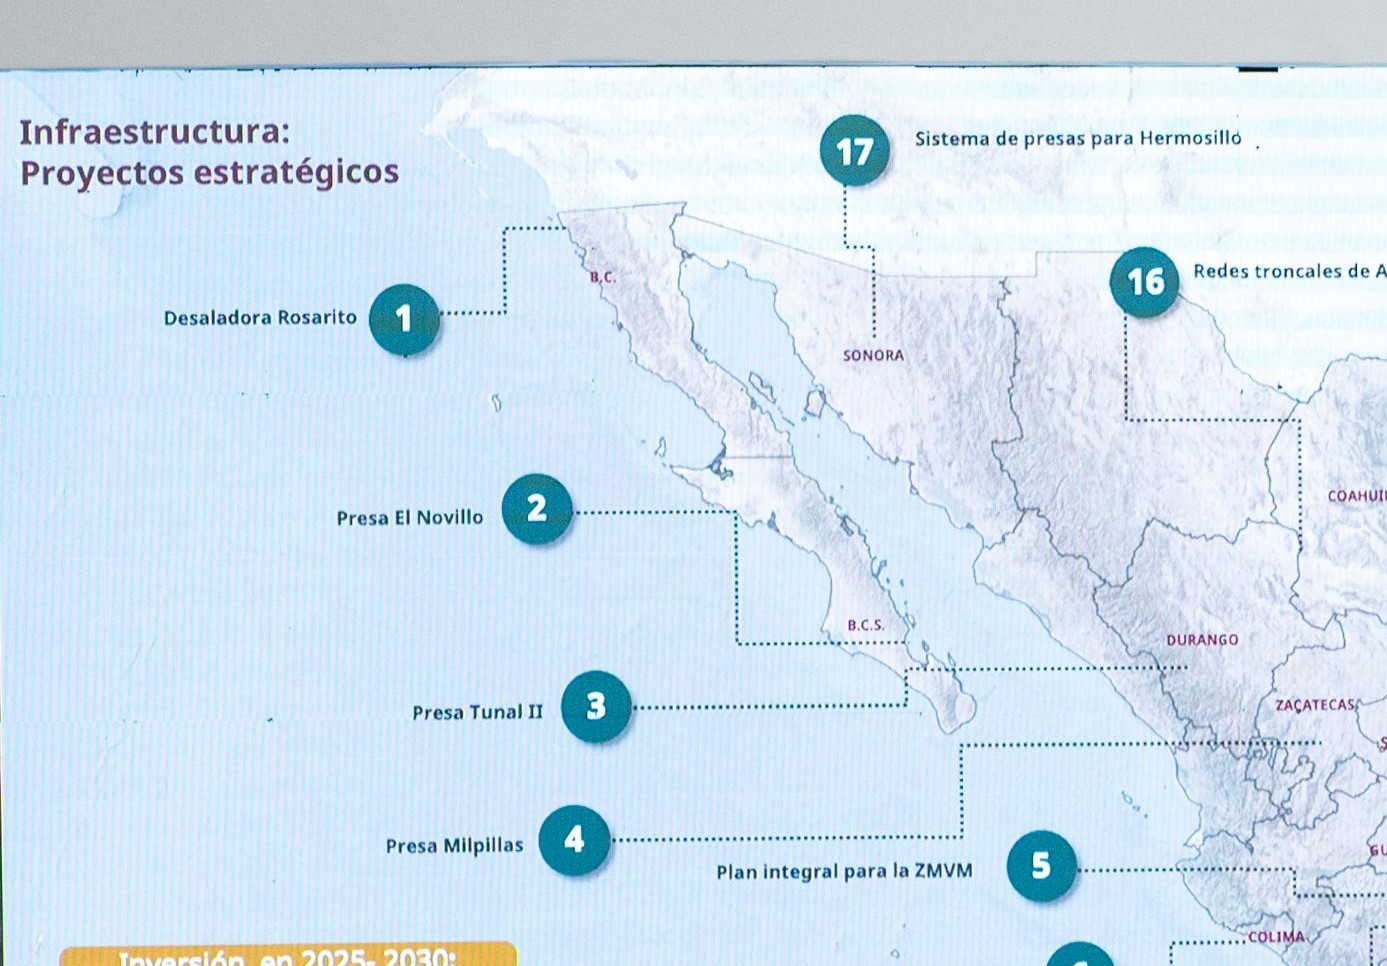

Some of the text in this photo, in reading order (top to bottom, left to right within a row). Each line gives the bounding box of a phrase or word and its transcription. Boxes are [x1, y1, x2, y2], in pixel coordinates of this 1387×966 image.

[20, 118, 290, 146] Infraestructura:
[916, 129, 1242, 150] Sistema de presas para Hermosillo
[836, 136, 874, 166] 17
[21, 156, 400, 193] Proyectos estratégicos
[591, 271, 616, 283] B.C.
[1127, 266, 1165, 296] 16
[1194, 263, 1248, 279] Redes
[1255, 263, 1342, 278] troncales
[1348, 263, 1370, 278] de
[165, 308, 358, 327] Desaladora Rosarito
[395, 305, 411, 332] 1
[843, 348, 904, 362] SONORA
[527, 493, 547, 521] 2
[337, 508, 484, 527] Presa El Novillo
[848, 618, 886, 633] B.C.S.
[1166, 633, 1239, 647] DURANGO
[413, 703, 544, 722] Presa Tunal II
[586, 693, 605, 720] 3
[1276, 699, 1354, 712] ZACATECAS
[386, 836, 524, 855] Presa Milpillas
[564, 826, 585, 852] 4
[717, 861, 973, 882] Plan integral para la ZMVM
[1031, 852, 1051, 879] 5
[1248, 930, 1305, 944] COLIMA
